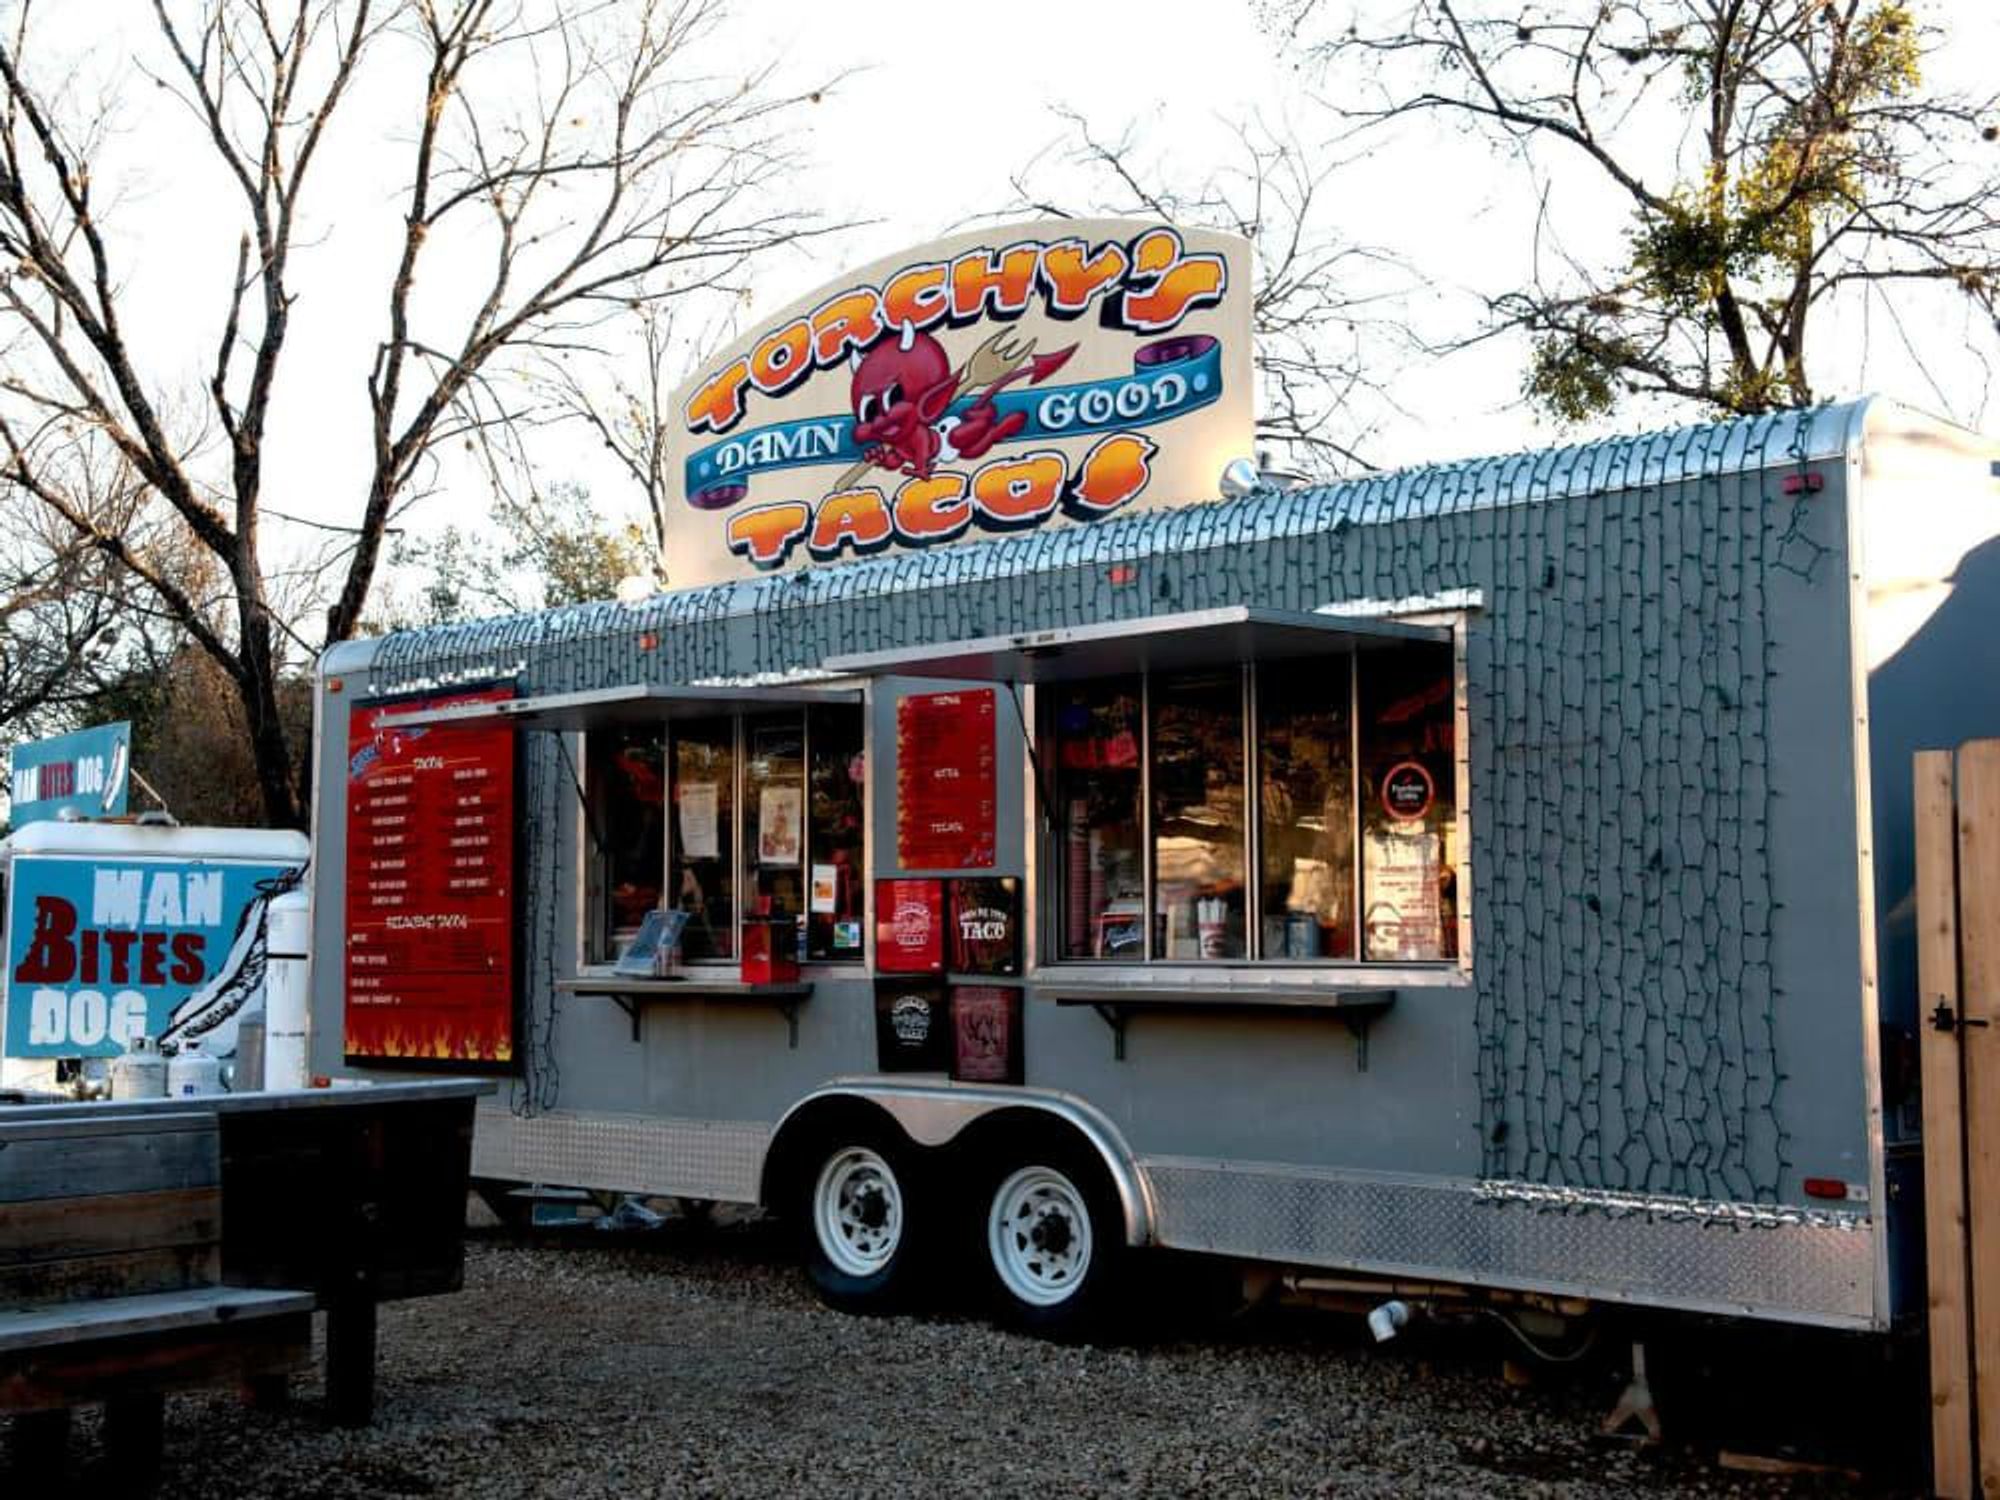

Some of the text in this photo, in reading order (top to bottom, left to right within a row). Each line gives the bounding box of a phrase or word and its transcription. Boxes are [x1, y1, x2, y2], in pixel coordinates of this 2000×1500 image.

[685, 226, 1228, 436] TORCHY'S
[716, 372, 1188, 475] DAMN GOOD
[726, 430, 1159, 570] TACOS
[13, 755, 104, 804] MAN BITES DOG
[93, 868, 224, 930] MAN
[959, 921, 1006, 940] TACO
[14, 895, 206, 985] BITES
[29, 988, 148, 1047] DOG
